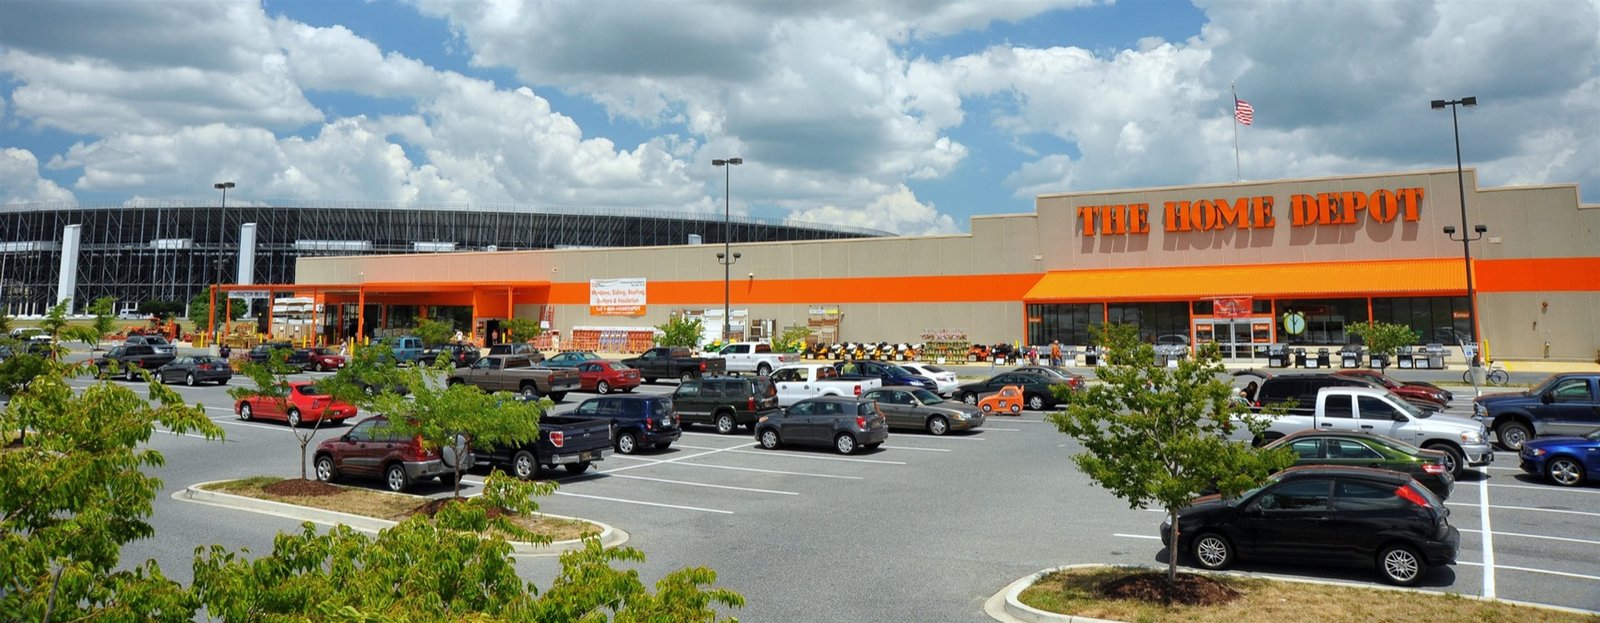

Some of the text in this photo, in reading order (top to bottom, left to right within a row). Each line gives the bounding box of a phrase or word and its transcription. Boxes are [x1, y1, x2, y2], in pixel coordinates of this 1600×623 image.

[1077, 187, 1424, 236] THE HOME DEPOT
